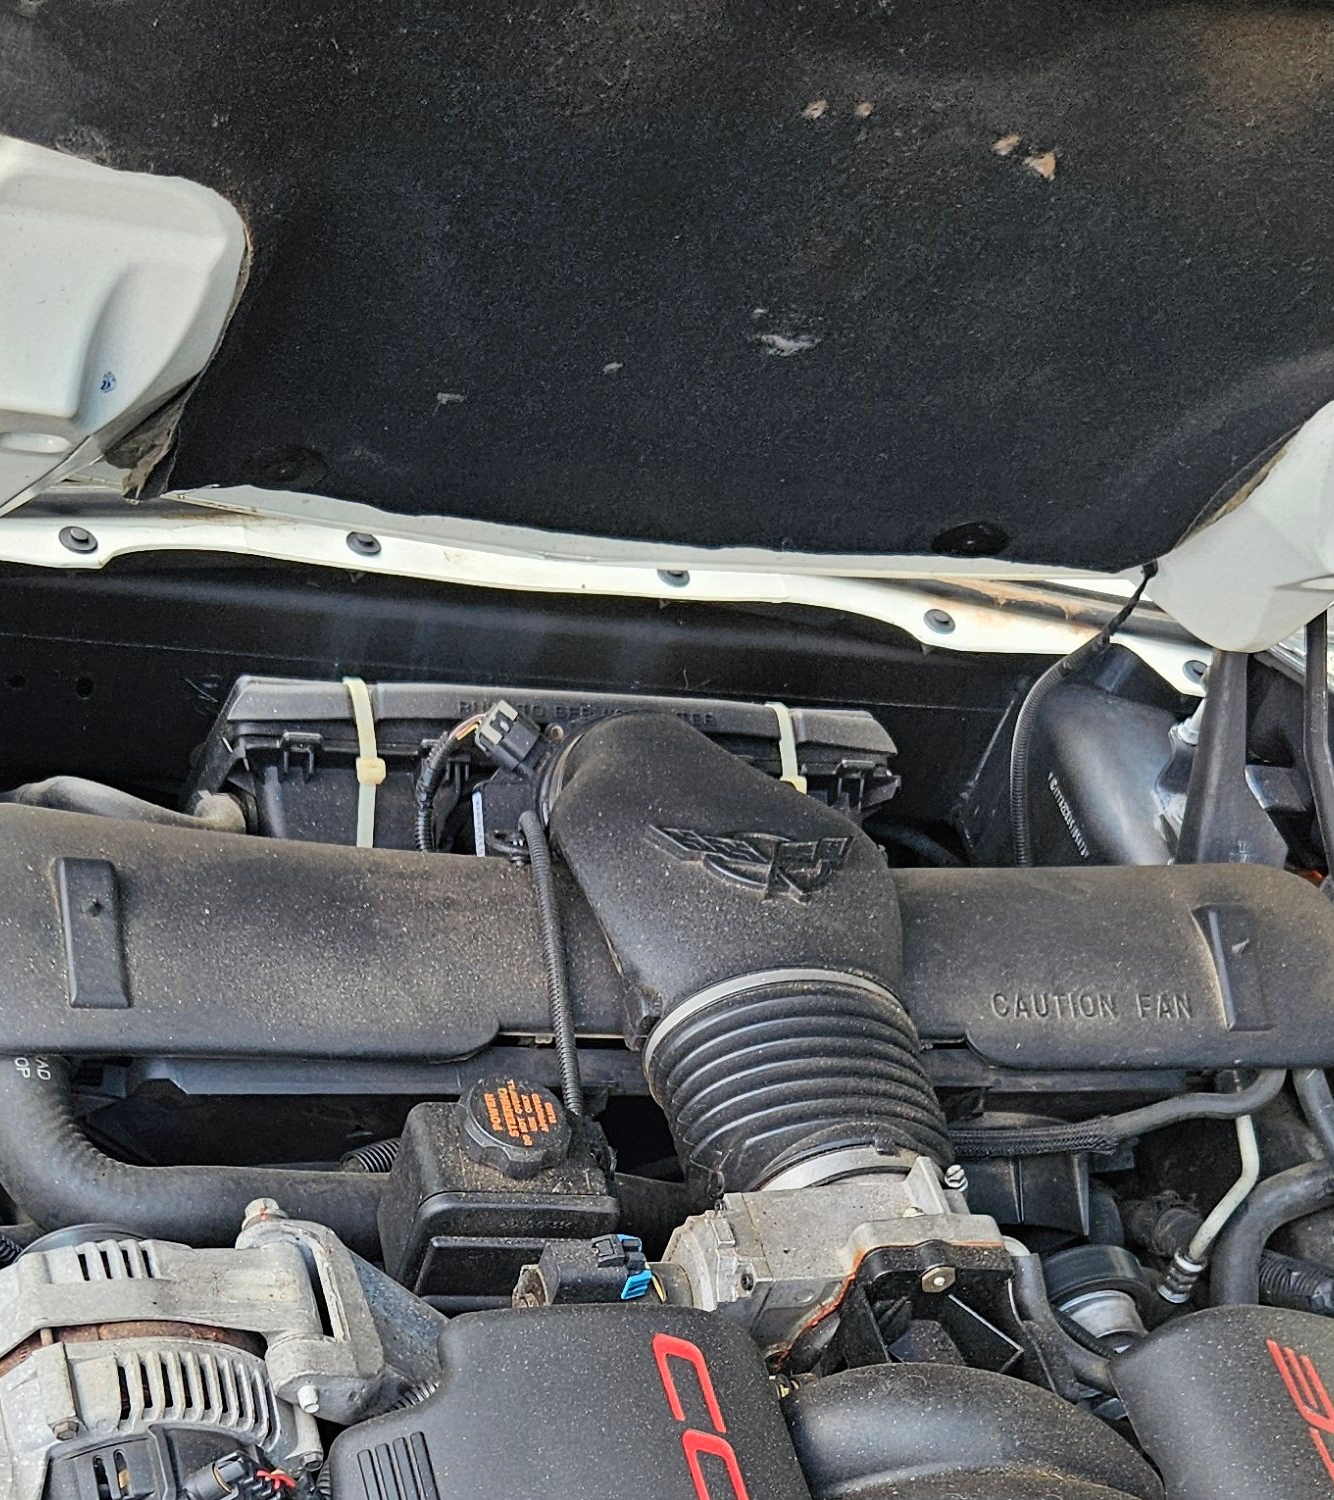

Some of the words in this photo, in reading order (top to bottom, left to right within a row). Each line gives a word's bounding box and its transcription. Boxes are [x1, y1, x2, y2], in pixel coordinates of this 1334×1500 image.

[990, 991, 1117, 1021] CAUTION
[1134, 991, 1194, 1020] FAN
[35, 1056, 51, 1079] AD
[483, 1093, 502, 1131] POWER
[497, 1087, 519, 1137] STEERING
